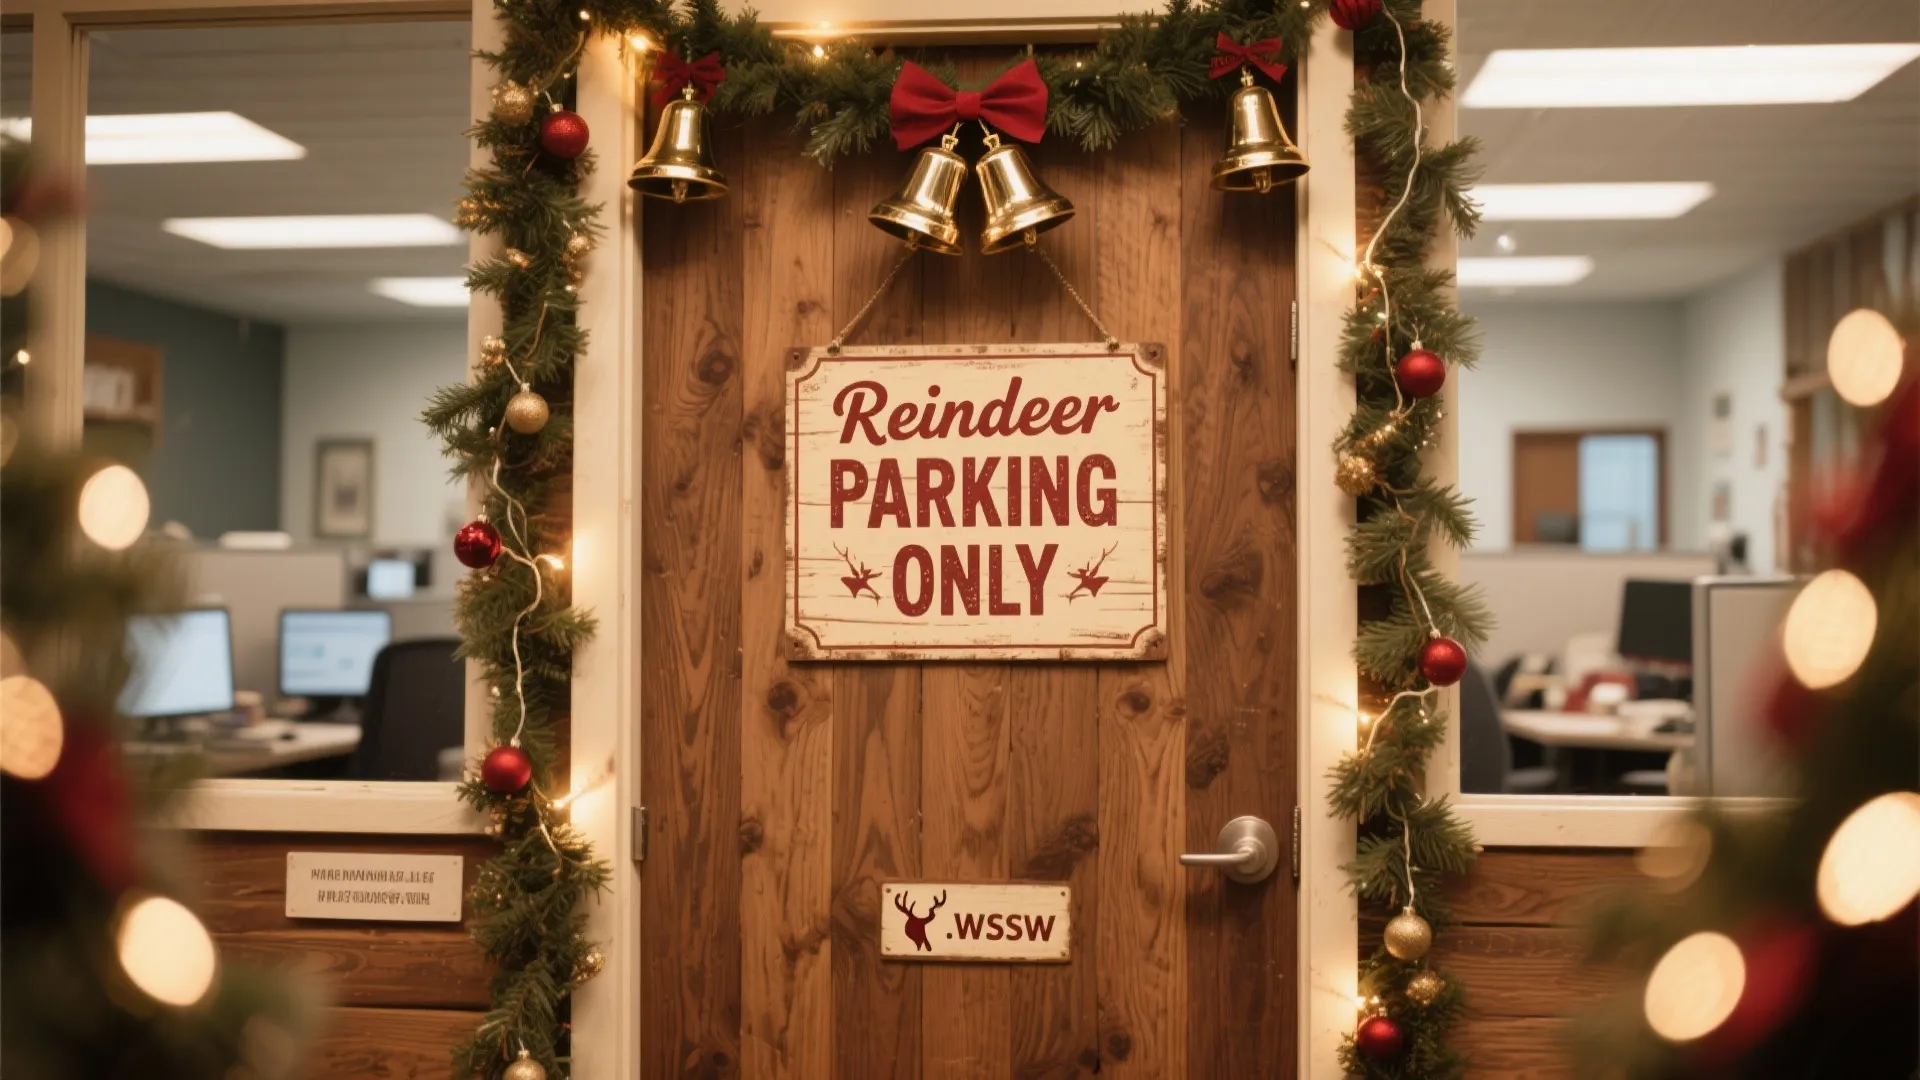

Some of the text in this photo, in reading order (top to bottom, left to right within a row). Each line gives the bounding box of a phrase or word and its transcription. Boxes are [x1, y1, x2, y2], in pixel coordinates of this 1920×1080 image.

[832, 376, 1120, 446] Reindeer
[829, 453, 1117, 529] PARKING
[892, 543, 1059, 617] ONLY
